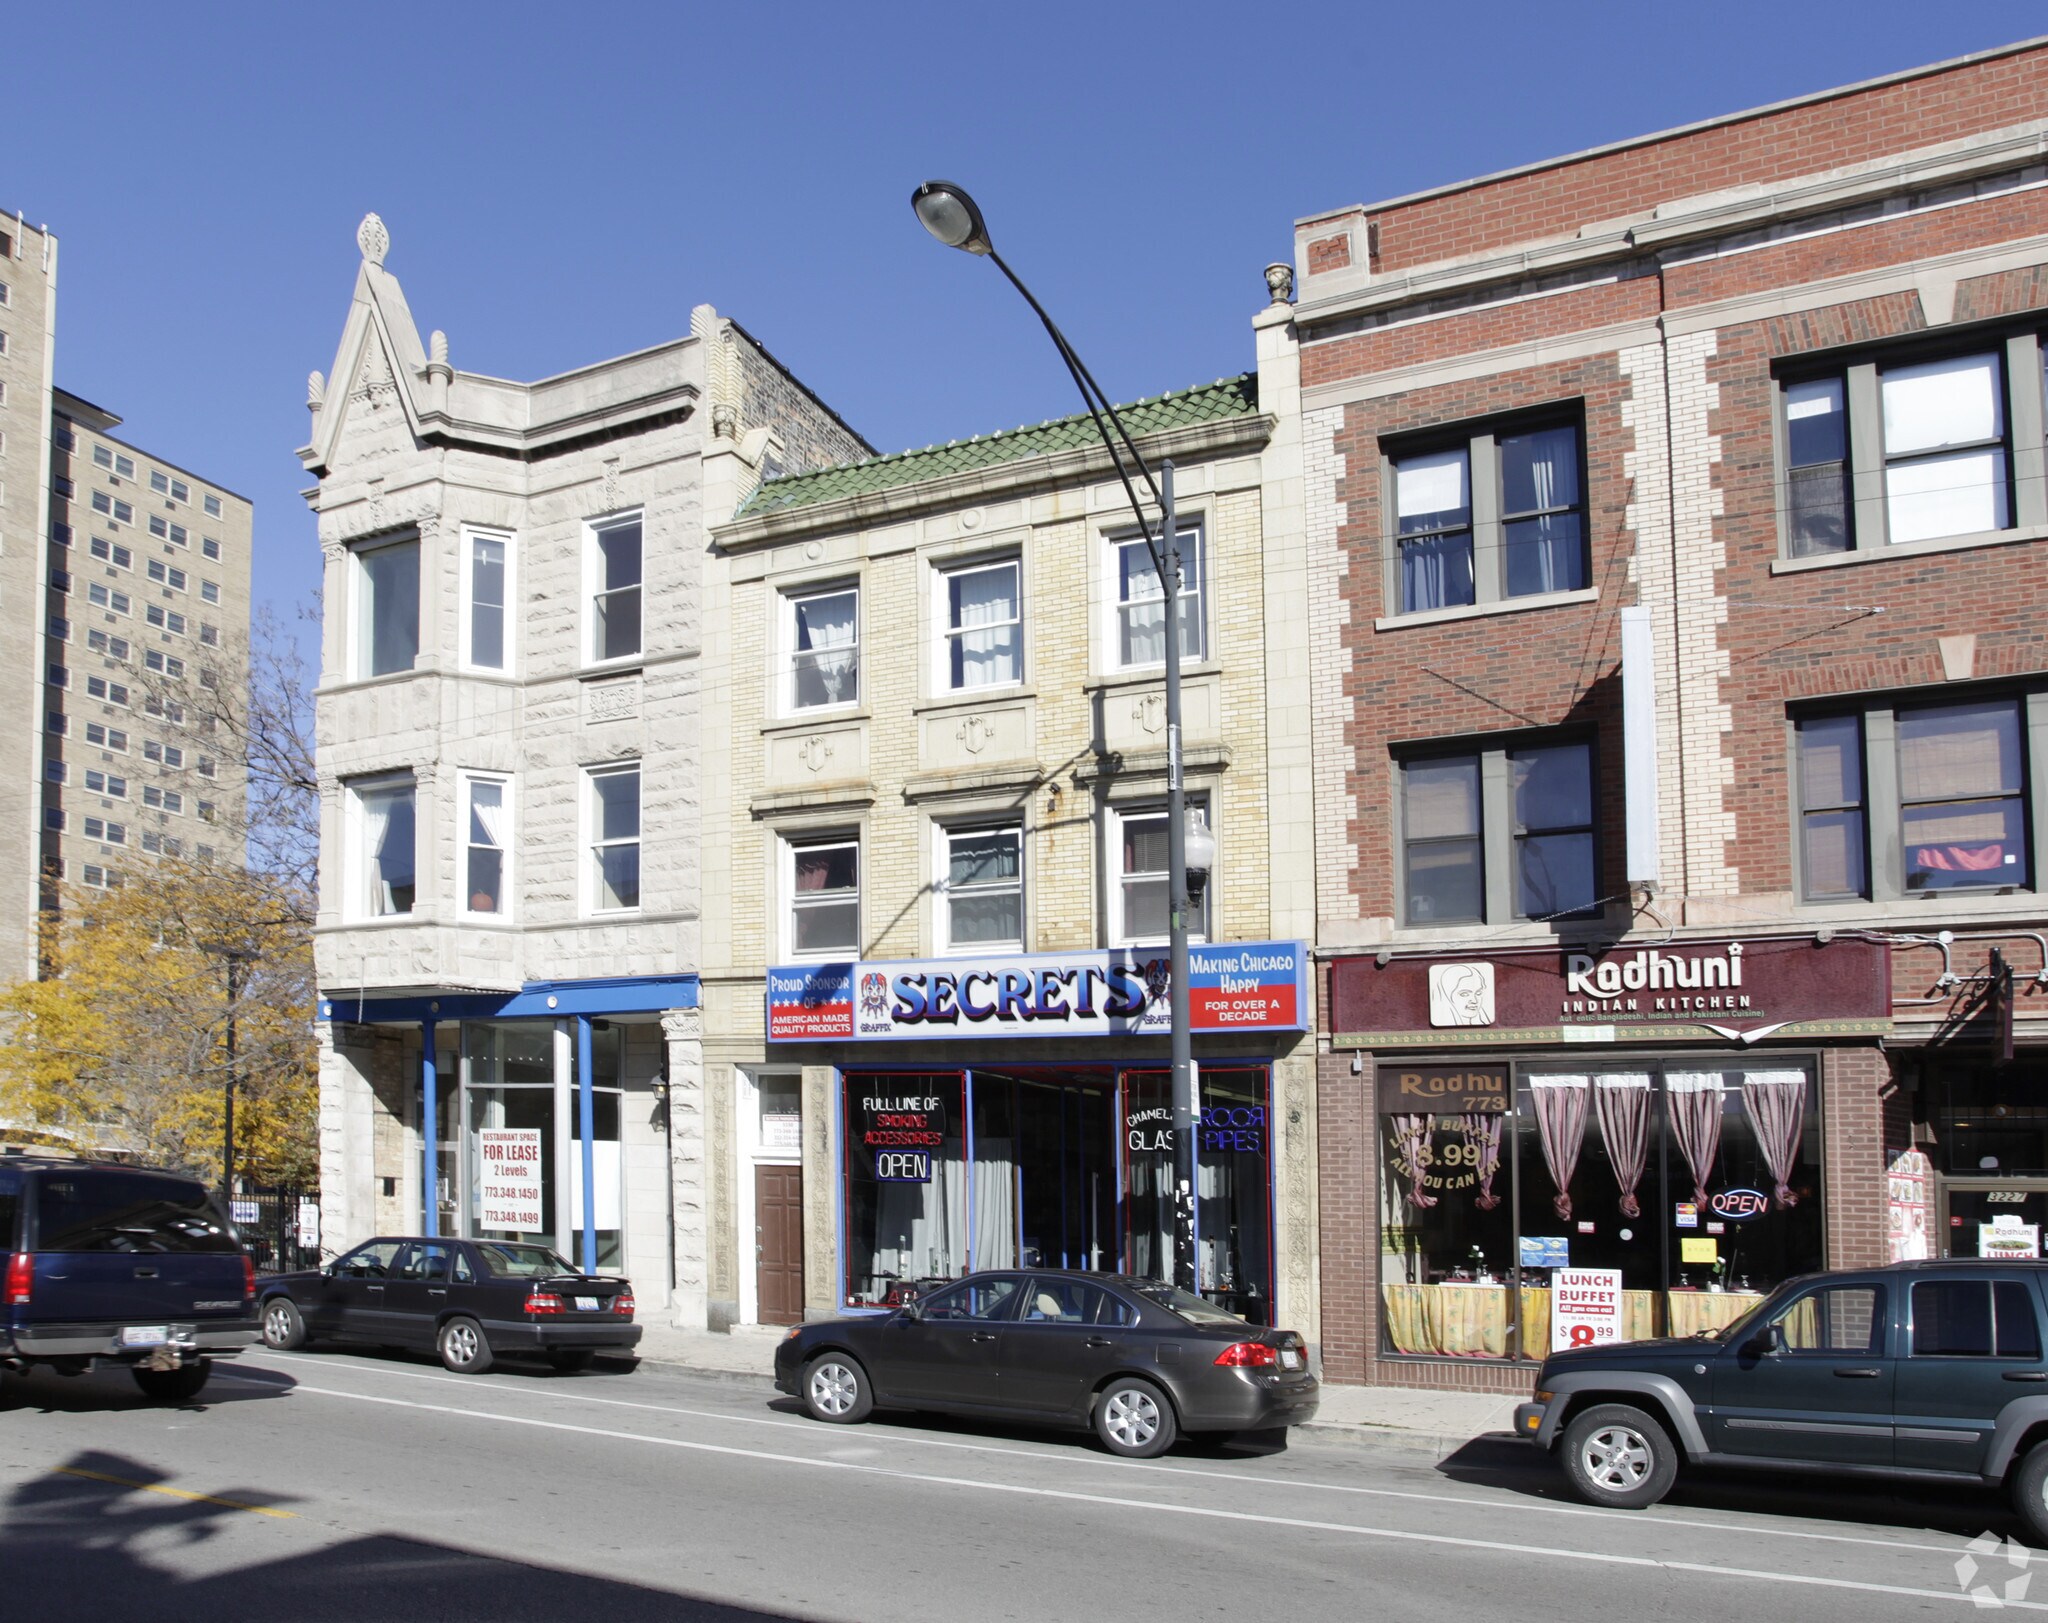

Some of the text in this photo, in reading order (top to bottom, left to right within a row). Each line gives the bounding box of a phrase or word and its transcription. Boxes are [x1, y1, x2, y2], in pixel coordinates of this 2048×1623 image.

[1190, 952, 1294, 974] MAKING CHICAGO
[1567, 943, 1744, 998] Radhuni
[771, 974, 850, 992] PROUD SPONSOR
[1220, 975, 1260, 994] HAPPY
[891, 963, 1146, 1026] SECRETS
[803, 997, 816, 1009] OF
[1205, 999, 1280, 1011] FOR OVER A
[1563, 995, 1750, 1012] INDIAN KITCHEN
[772, 1014, 850, 1025] AMERICAN MADE
[1219, 1011, 1267, 1021] DECADE
[1692, 1010, 1729, 1018] Pakistani
[772, 1024, 851, 1034] QUALITY PRODUCTS
[860, 1023, 891, 1032] GRAFFIX
[863, 1097, 940, 1111] FULL LINE OF
[1463, 1096, 1508, 1111] 773
[876, 1113, 928, 1128] SMOKING
[483, 1133, 537, 1141] RESTAURANT SPACE
[864, 1131, 943, 1145] ACCESSORIES
[1205, 1130, 1260, 1151] PIPES
[1389, 1119, 1501, 1149] LUNCH BUFFET
[483, 1145, 538, 1161] FOR LEASE
[494, 1164, 528, 1177] 2 Levels
[878, 1153, 927, 1179] OPEN
[1445, 1172, 1475, 1190] CAN
[485, 1186, 538, 1200] 773.348.1450
[1989, 1192, 2027, 1201] 3227
[1711, 1194, 1768, 1213] OPEN
[485, 1210, 539, 1224] 773.348.1499
[1561, 1274, 1613, 1287] LUNCH
[1559, 1290, 1615, 1303] BUFFET
[1560, 1324, 1614, 1348] $ 8 99
